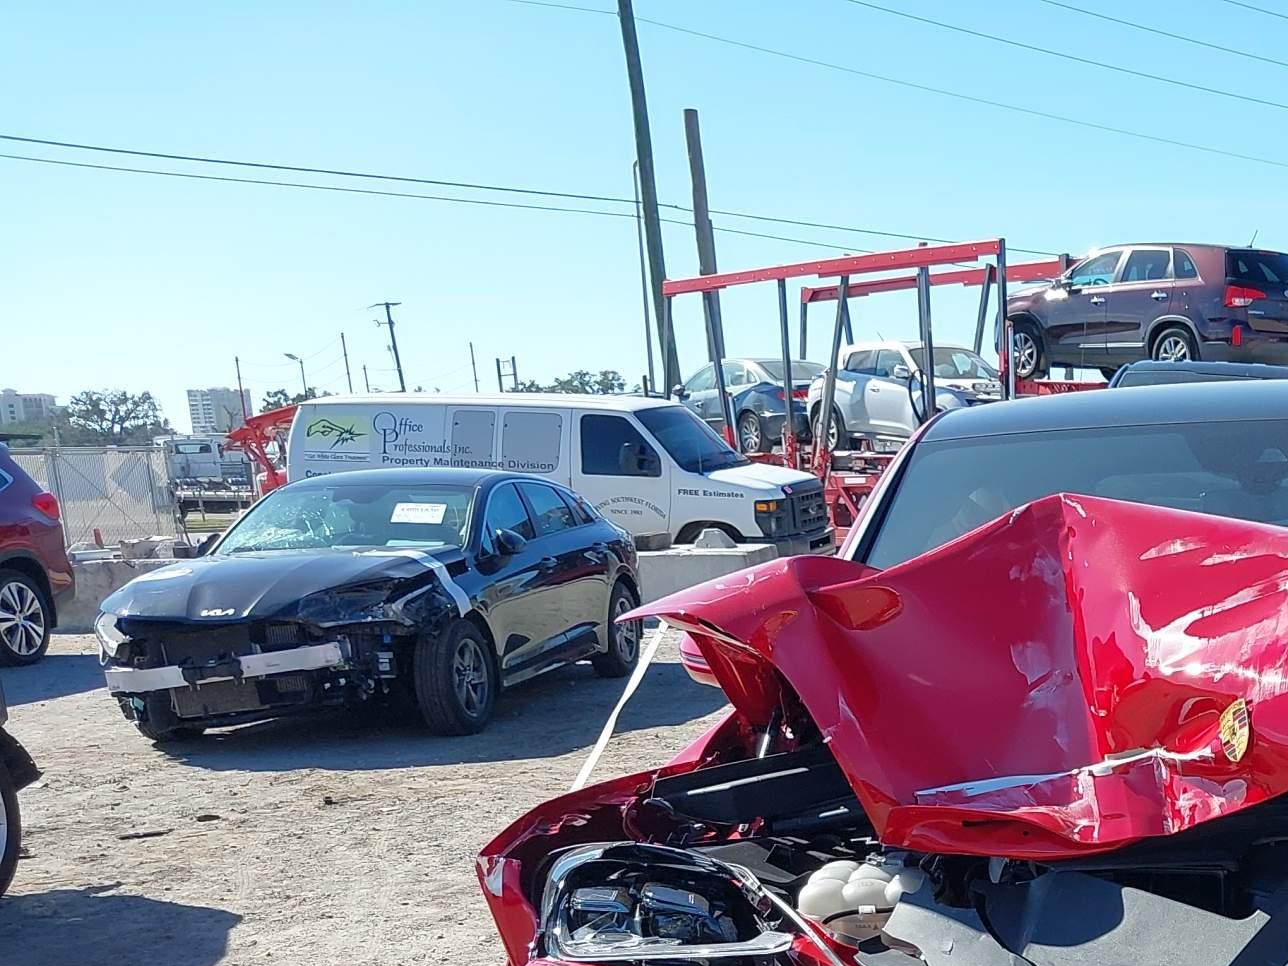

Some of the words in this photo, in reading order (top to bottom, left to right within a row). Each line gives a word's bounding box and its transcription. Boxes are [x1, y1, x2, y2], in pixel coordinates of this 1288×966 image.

[373, 412, 423, 435] Office
[380, 428, 451, 455] Professionals
[454, 444, 472, 454] Inc.
[382, 456, 431, 467] Property
[434, 457, 504, 469] Maintenance
[508, 460, 554, 470] Division
[703, 490, 744, 498] Estimates
